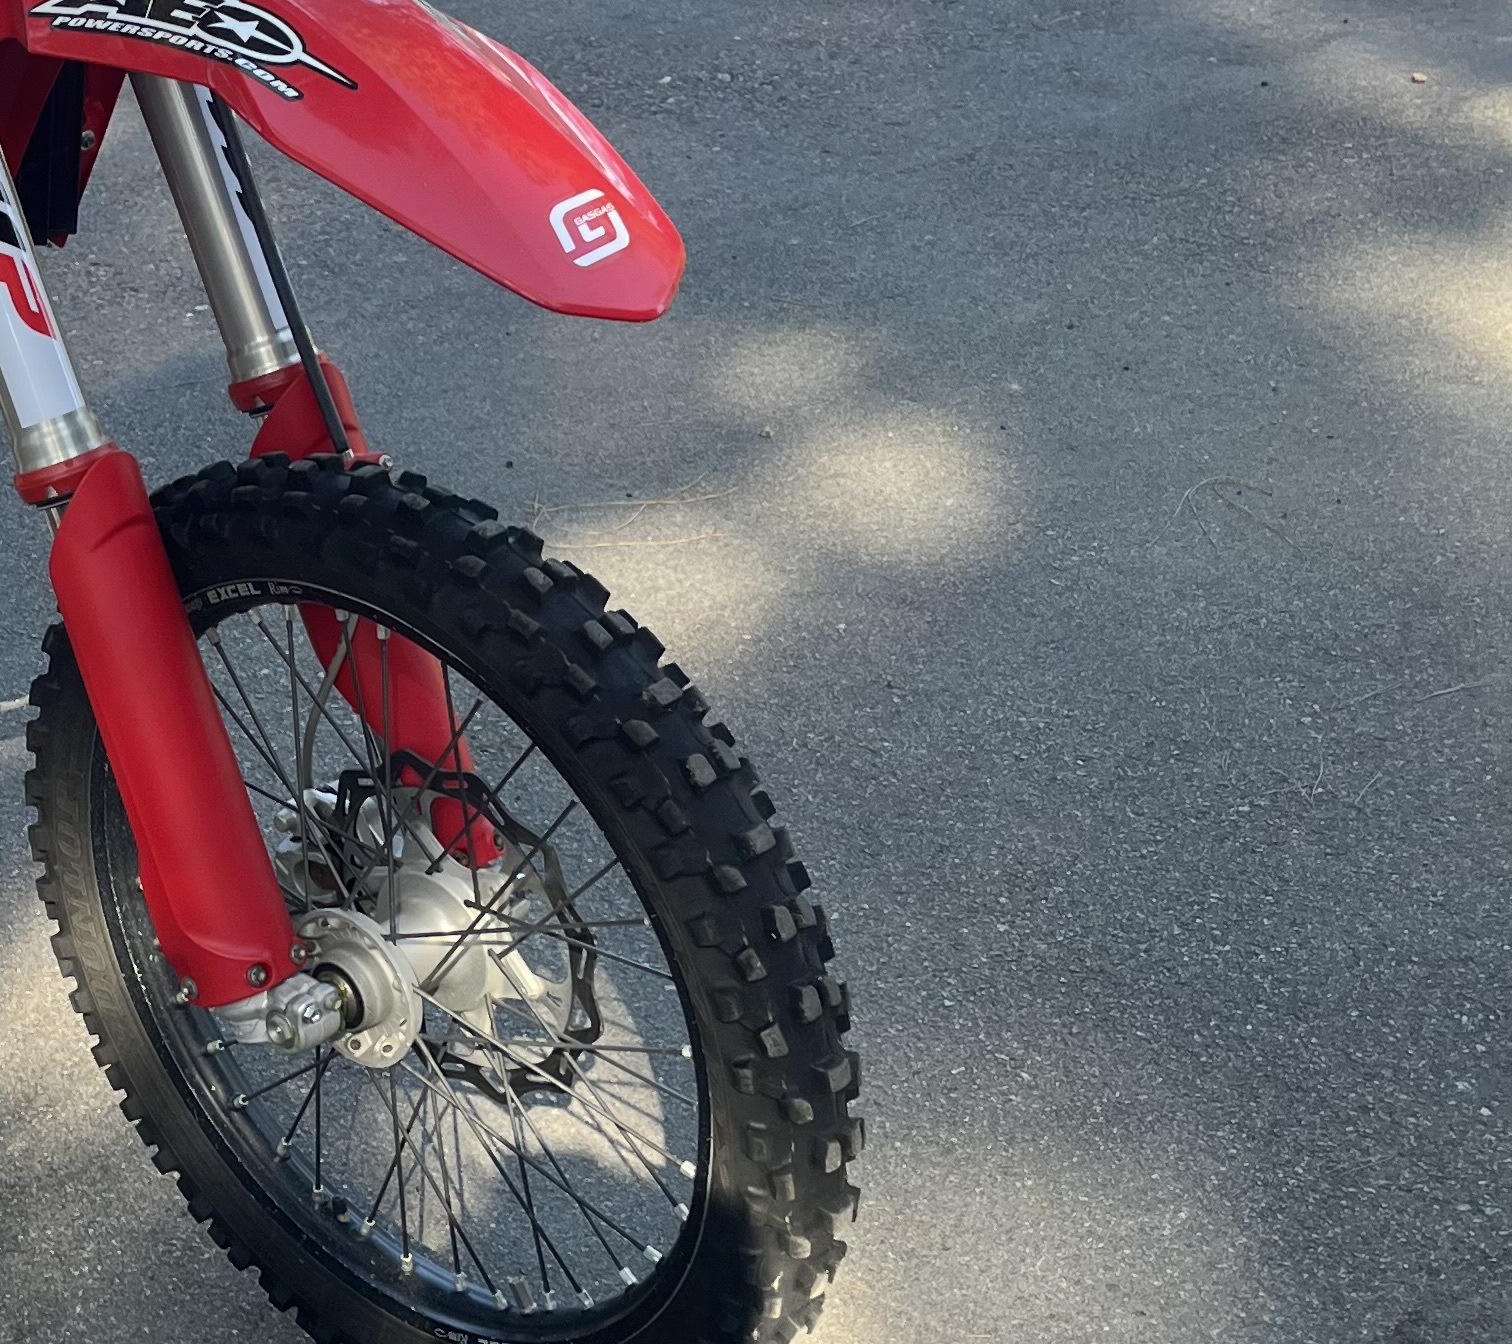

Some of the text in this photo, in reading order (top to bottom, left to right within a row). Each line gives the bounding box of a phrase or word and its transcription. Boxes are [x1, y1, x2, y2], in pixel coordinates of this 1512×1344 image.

[51, 15, 300, 99] POWERSPORTS.COM
[573, 202, 615, 226] GASGAS
[206, 582, 262, 605] EXCEL
